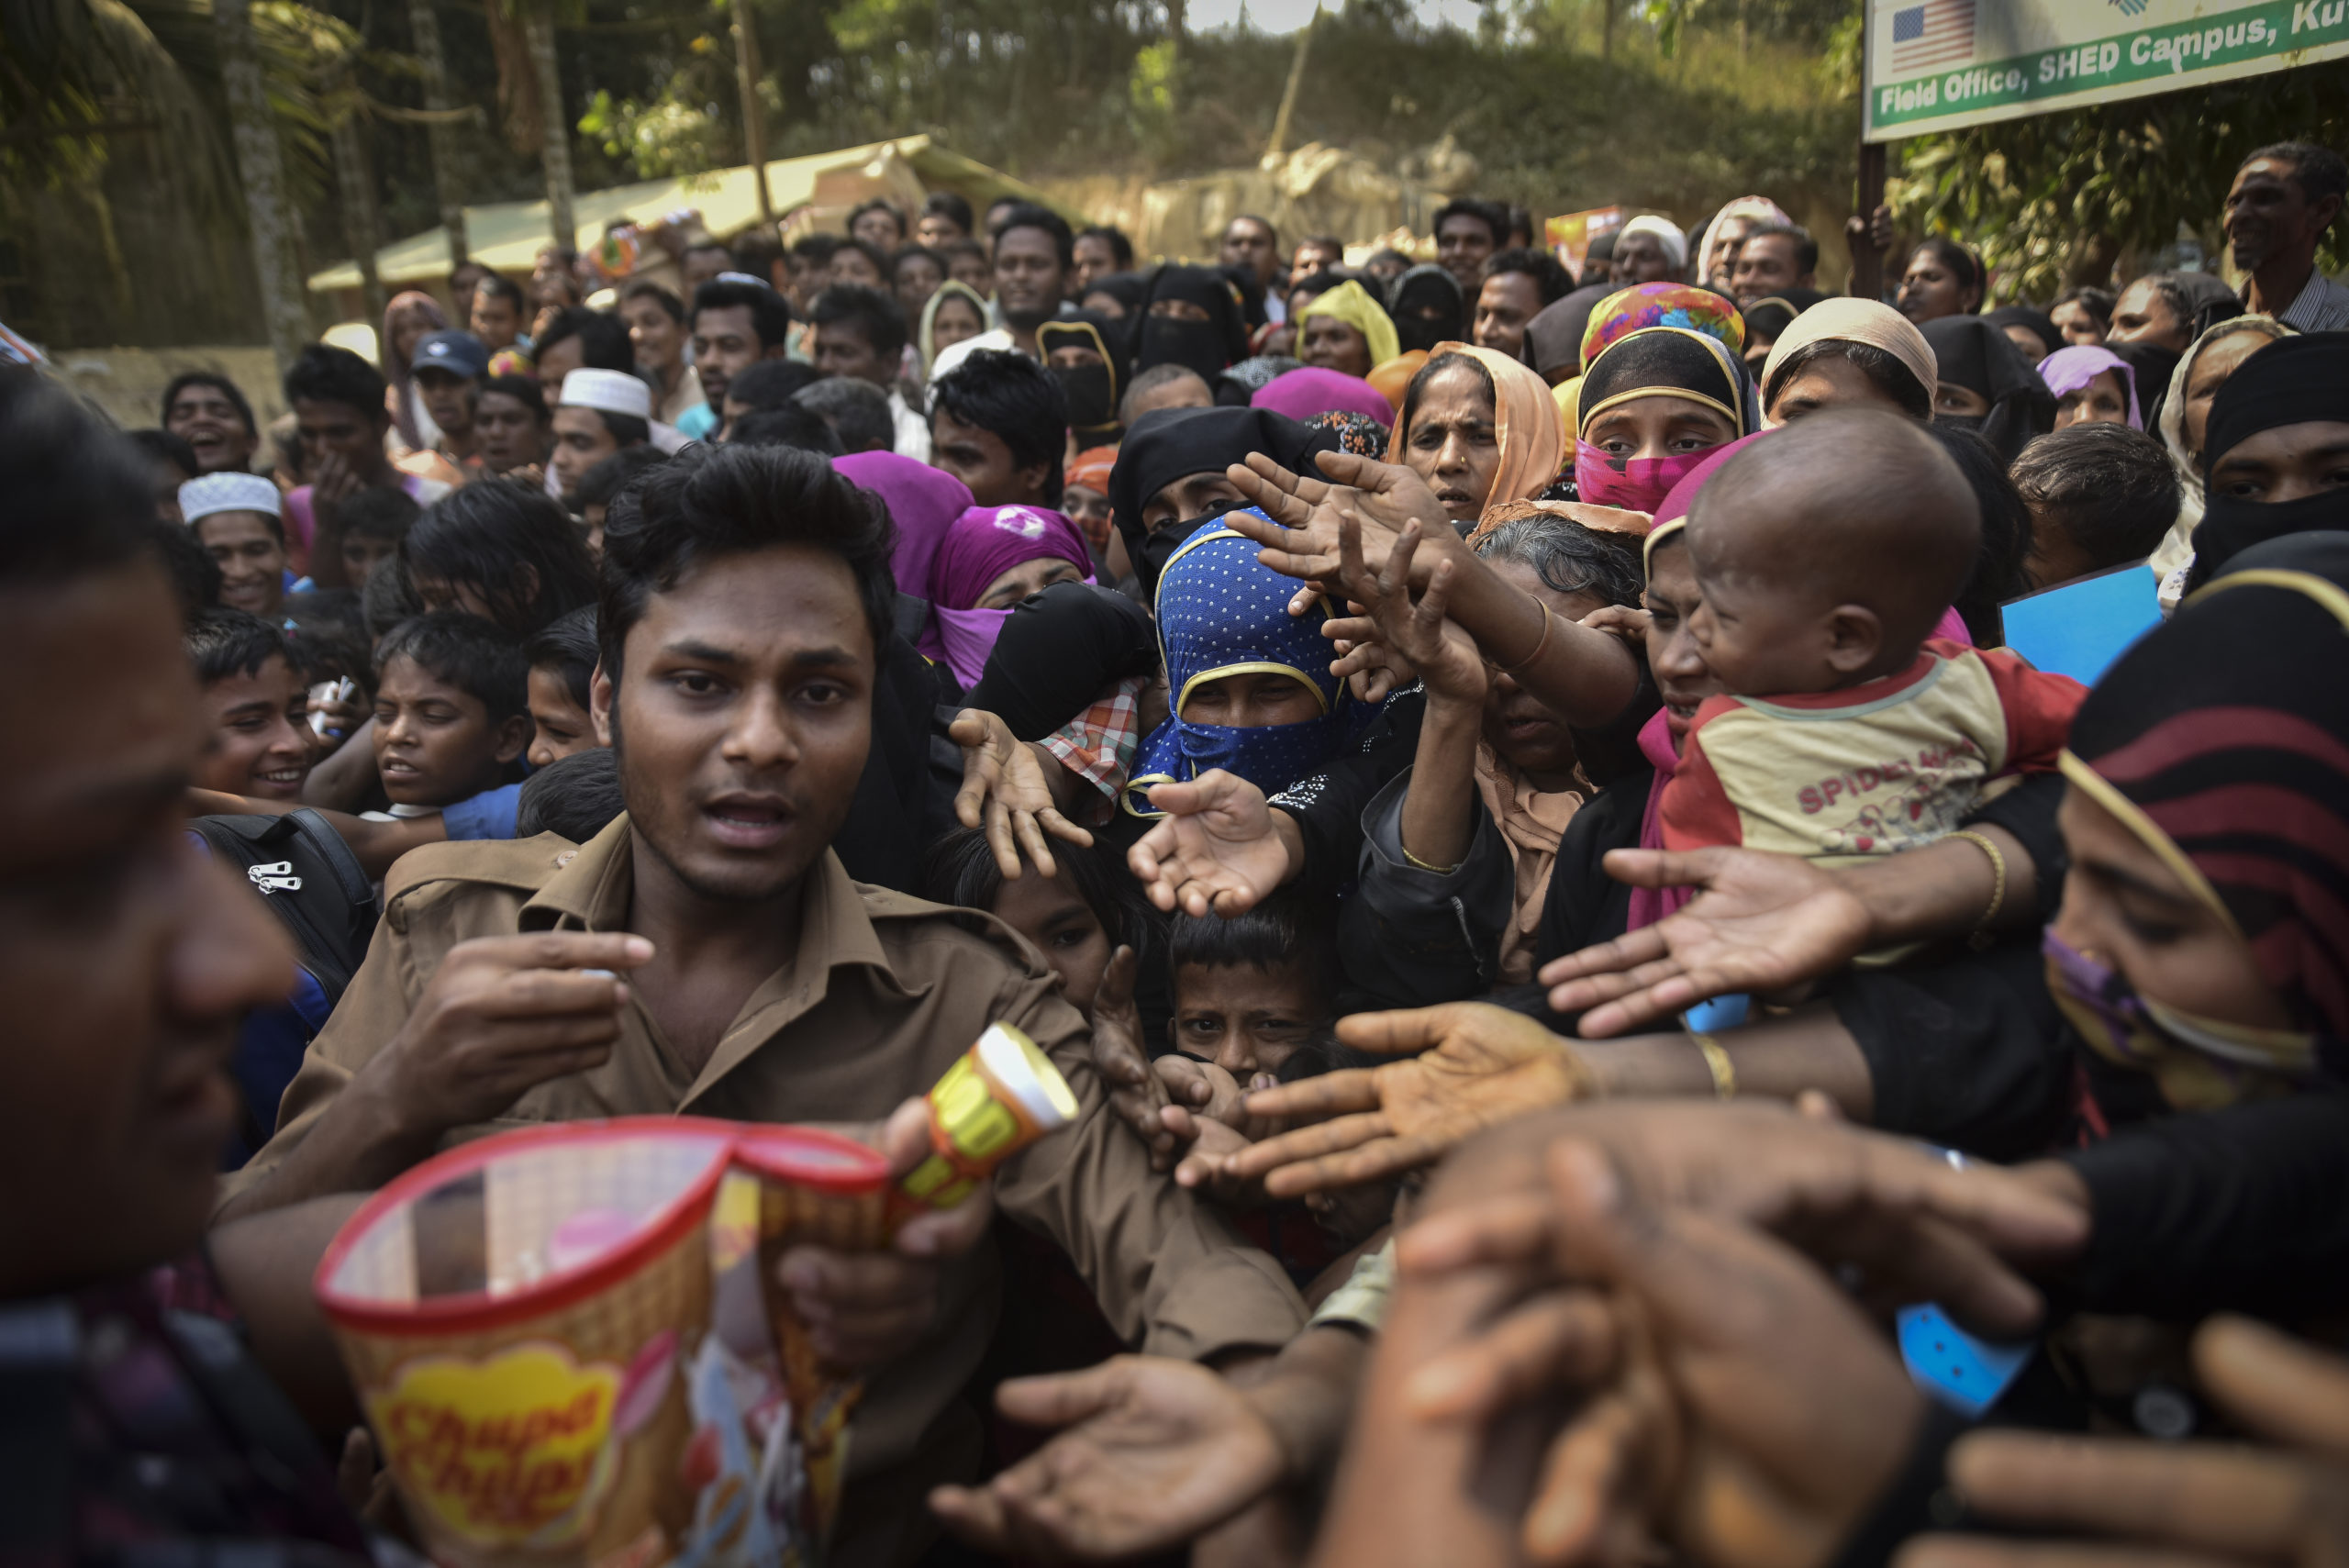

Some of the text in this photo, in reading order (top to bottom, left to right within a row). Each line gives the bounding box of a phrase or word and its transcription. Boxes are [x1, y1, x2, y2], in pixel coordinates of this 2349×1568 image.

[1880, 0, 2349, 116] Field Office, SHED Campus, Ku
